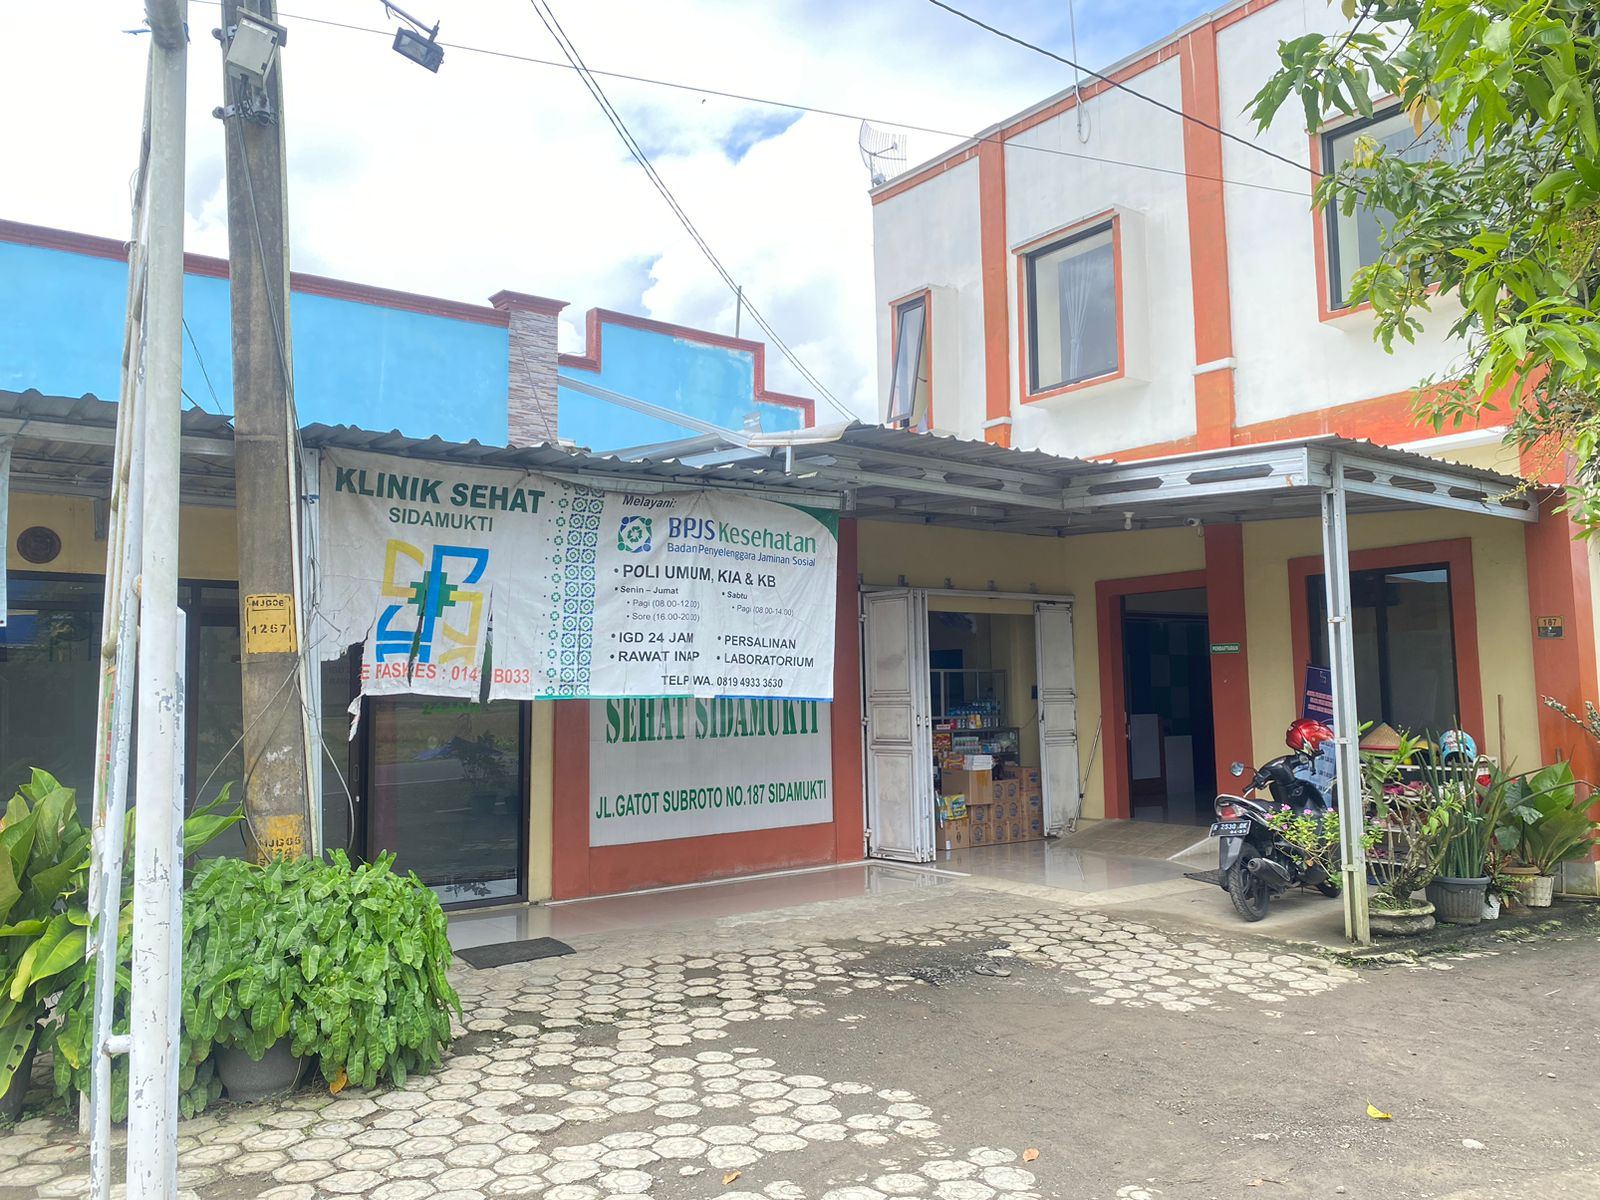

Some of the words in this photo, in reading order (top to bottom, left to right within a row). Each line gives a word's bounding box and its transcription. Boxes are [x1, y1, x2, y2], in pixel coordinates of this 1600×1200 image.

[335, 466, 443, 504] KLINIK
[450, 483, 546, 514] SEHAT
[622, 494, 677, 510] Melayani:
[389, 507, 493, 532] SIDAMUKTI
[668, 517, 716, 541] BPJS
[718, 521, 816, 553] Kesehatan
[667, 543, 697, 553] Badan
[698, 544, 756, 562] Penyelenggara
[757, 553, 790, 564] Jaminan
[792, 557, 816, 567] Sosial
[623, 564, 660, 578] POLI
[665, 565, 714, 583] UMUM,
[718, 569, 742, 585] KIA
[745, 572, 753, 585] &
[757, 574, 776, 588] KB
[620, 585, 644, 593] Senin
[653, 586, 679, 594] Jumat
[727, 590, 748, 600] Sabtu
[632, 599, 651, 608] Pagi
[737, 604, 752, 614] Pagi
[632, 612, 651, 621] Sore
[620, 632, 644, 643] IGD
[648, 632, 665, 643] 24
[669, 632, 694, 643] JAM
[724, 634, 796, 650] PERSALINAN
[618, 651, 670, 662] RAWAT
[674, 651, 700, 662] INAP
[724, 653, 814, 668] LABORATORIUM
[692, 675, 713, 686] WA.
[716, 676, 738, 687] 0819
[740, 677, 760, 687] 4933
[606, 698, 688, 744] SEHAT
[695, 698, 818, 740] SIDAMUKTI
[595, 791, 660, 819] JL.GATOT
[663, 786, 722, 812] SUBROTO
[726, 784, 765, 808] NO.187
[768, 779, 827, 803] SIDAMUKTI
